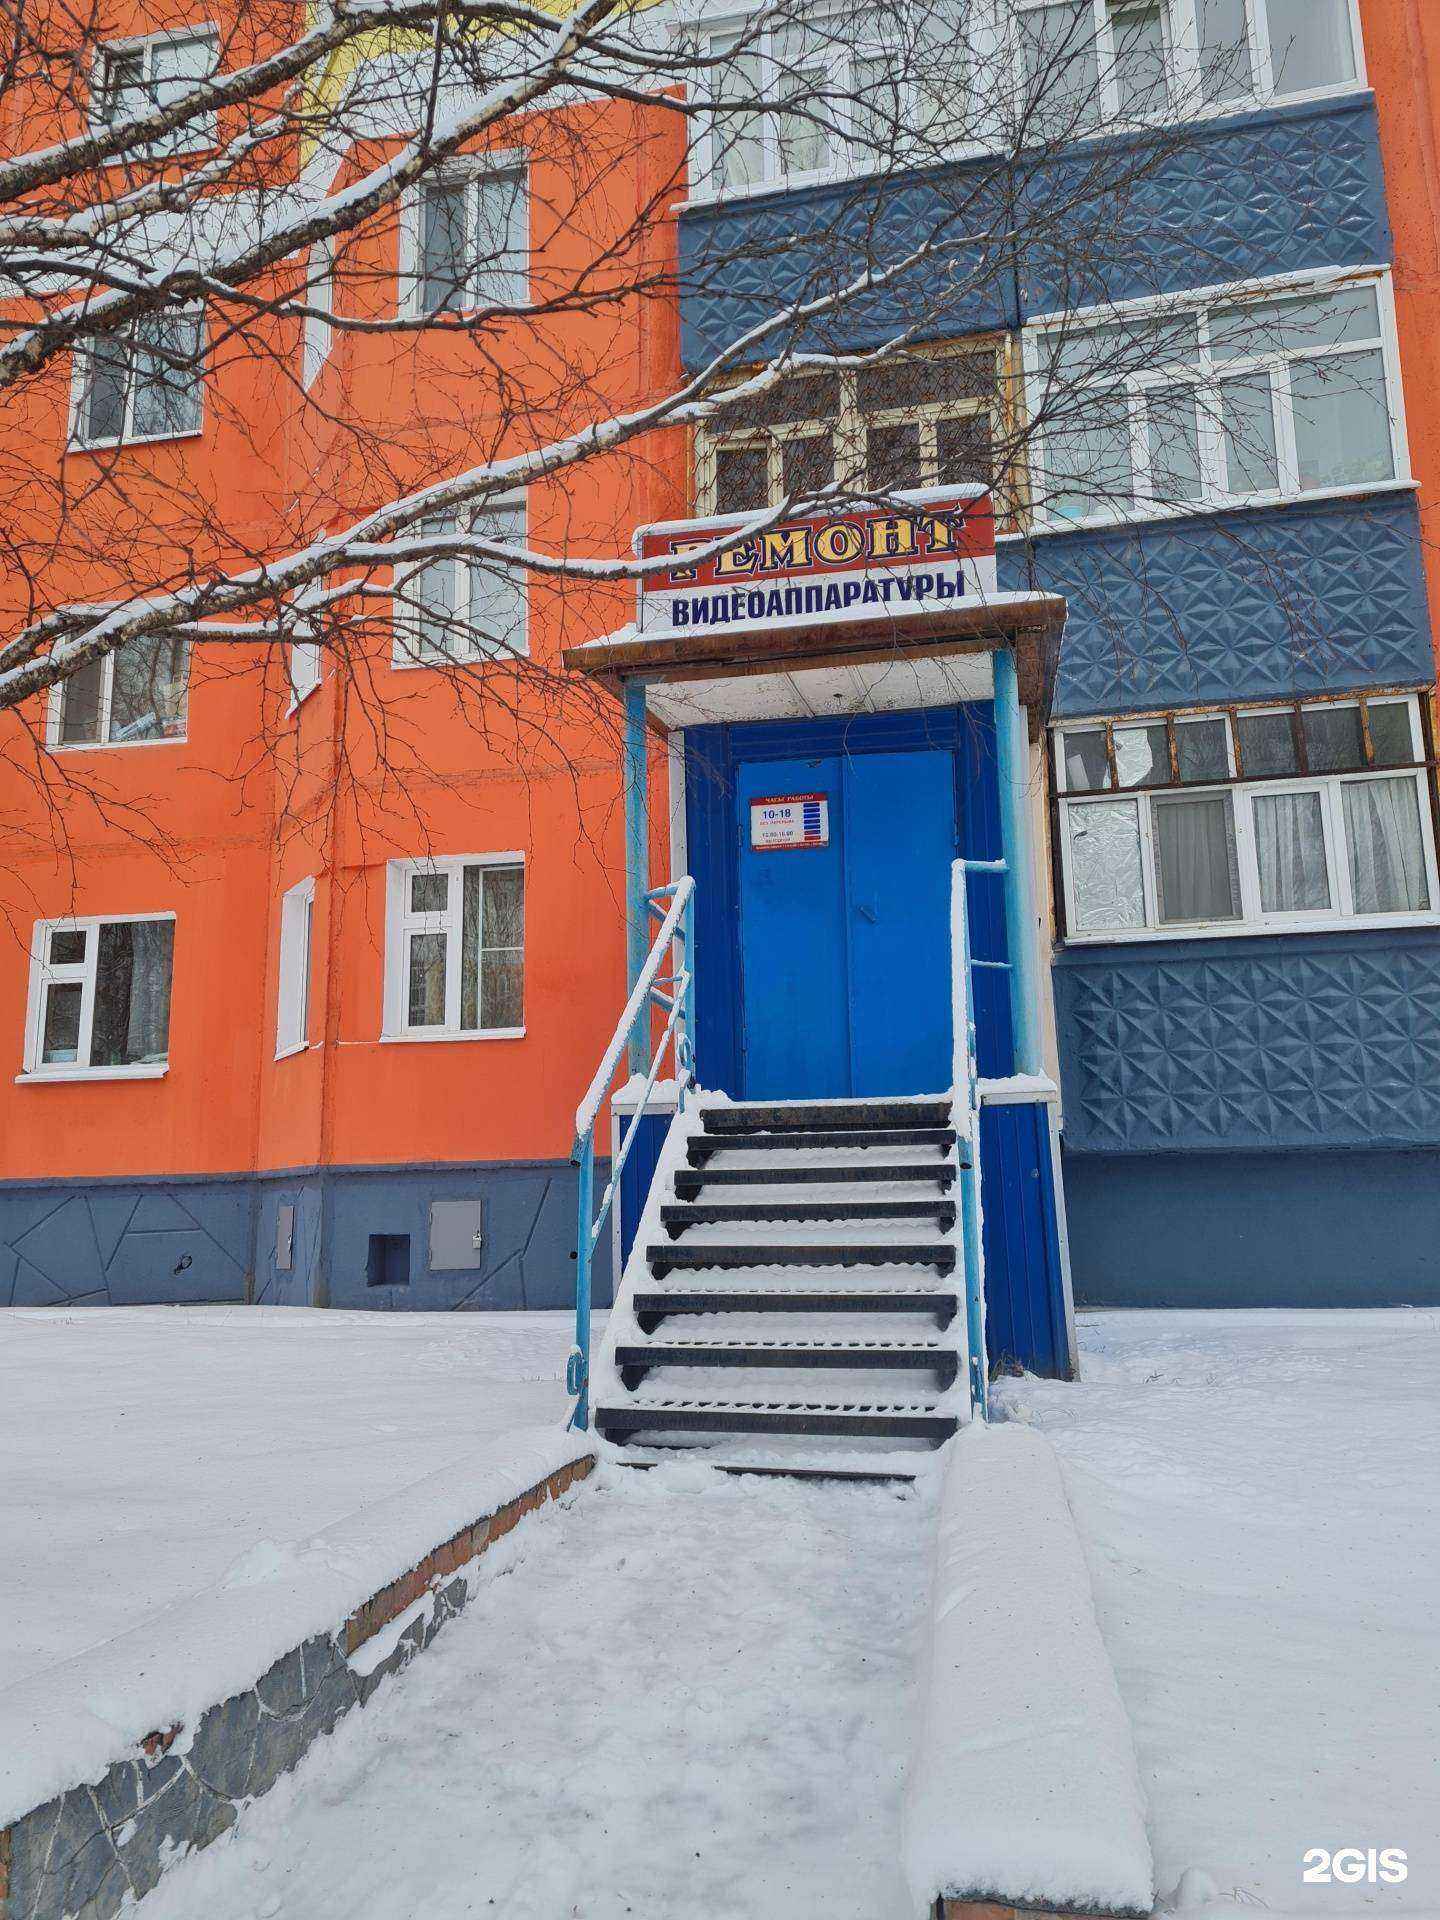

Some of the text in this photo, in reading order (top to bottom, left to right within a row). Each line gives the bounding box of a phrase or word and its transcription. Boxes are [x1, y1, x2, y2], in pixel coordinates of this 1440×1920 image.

[672, 570, 965, 627] ВИДЕОАППАРАТУРЫ
[787, 794, 814, 802] РАБОТЫ
[763, 808, 791, 819] 10-18
